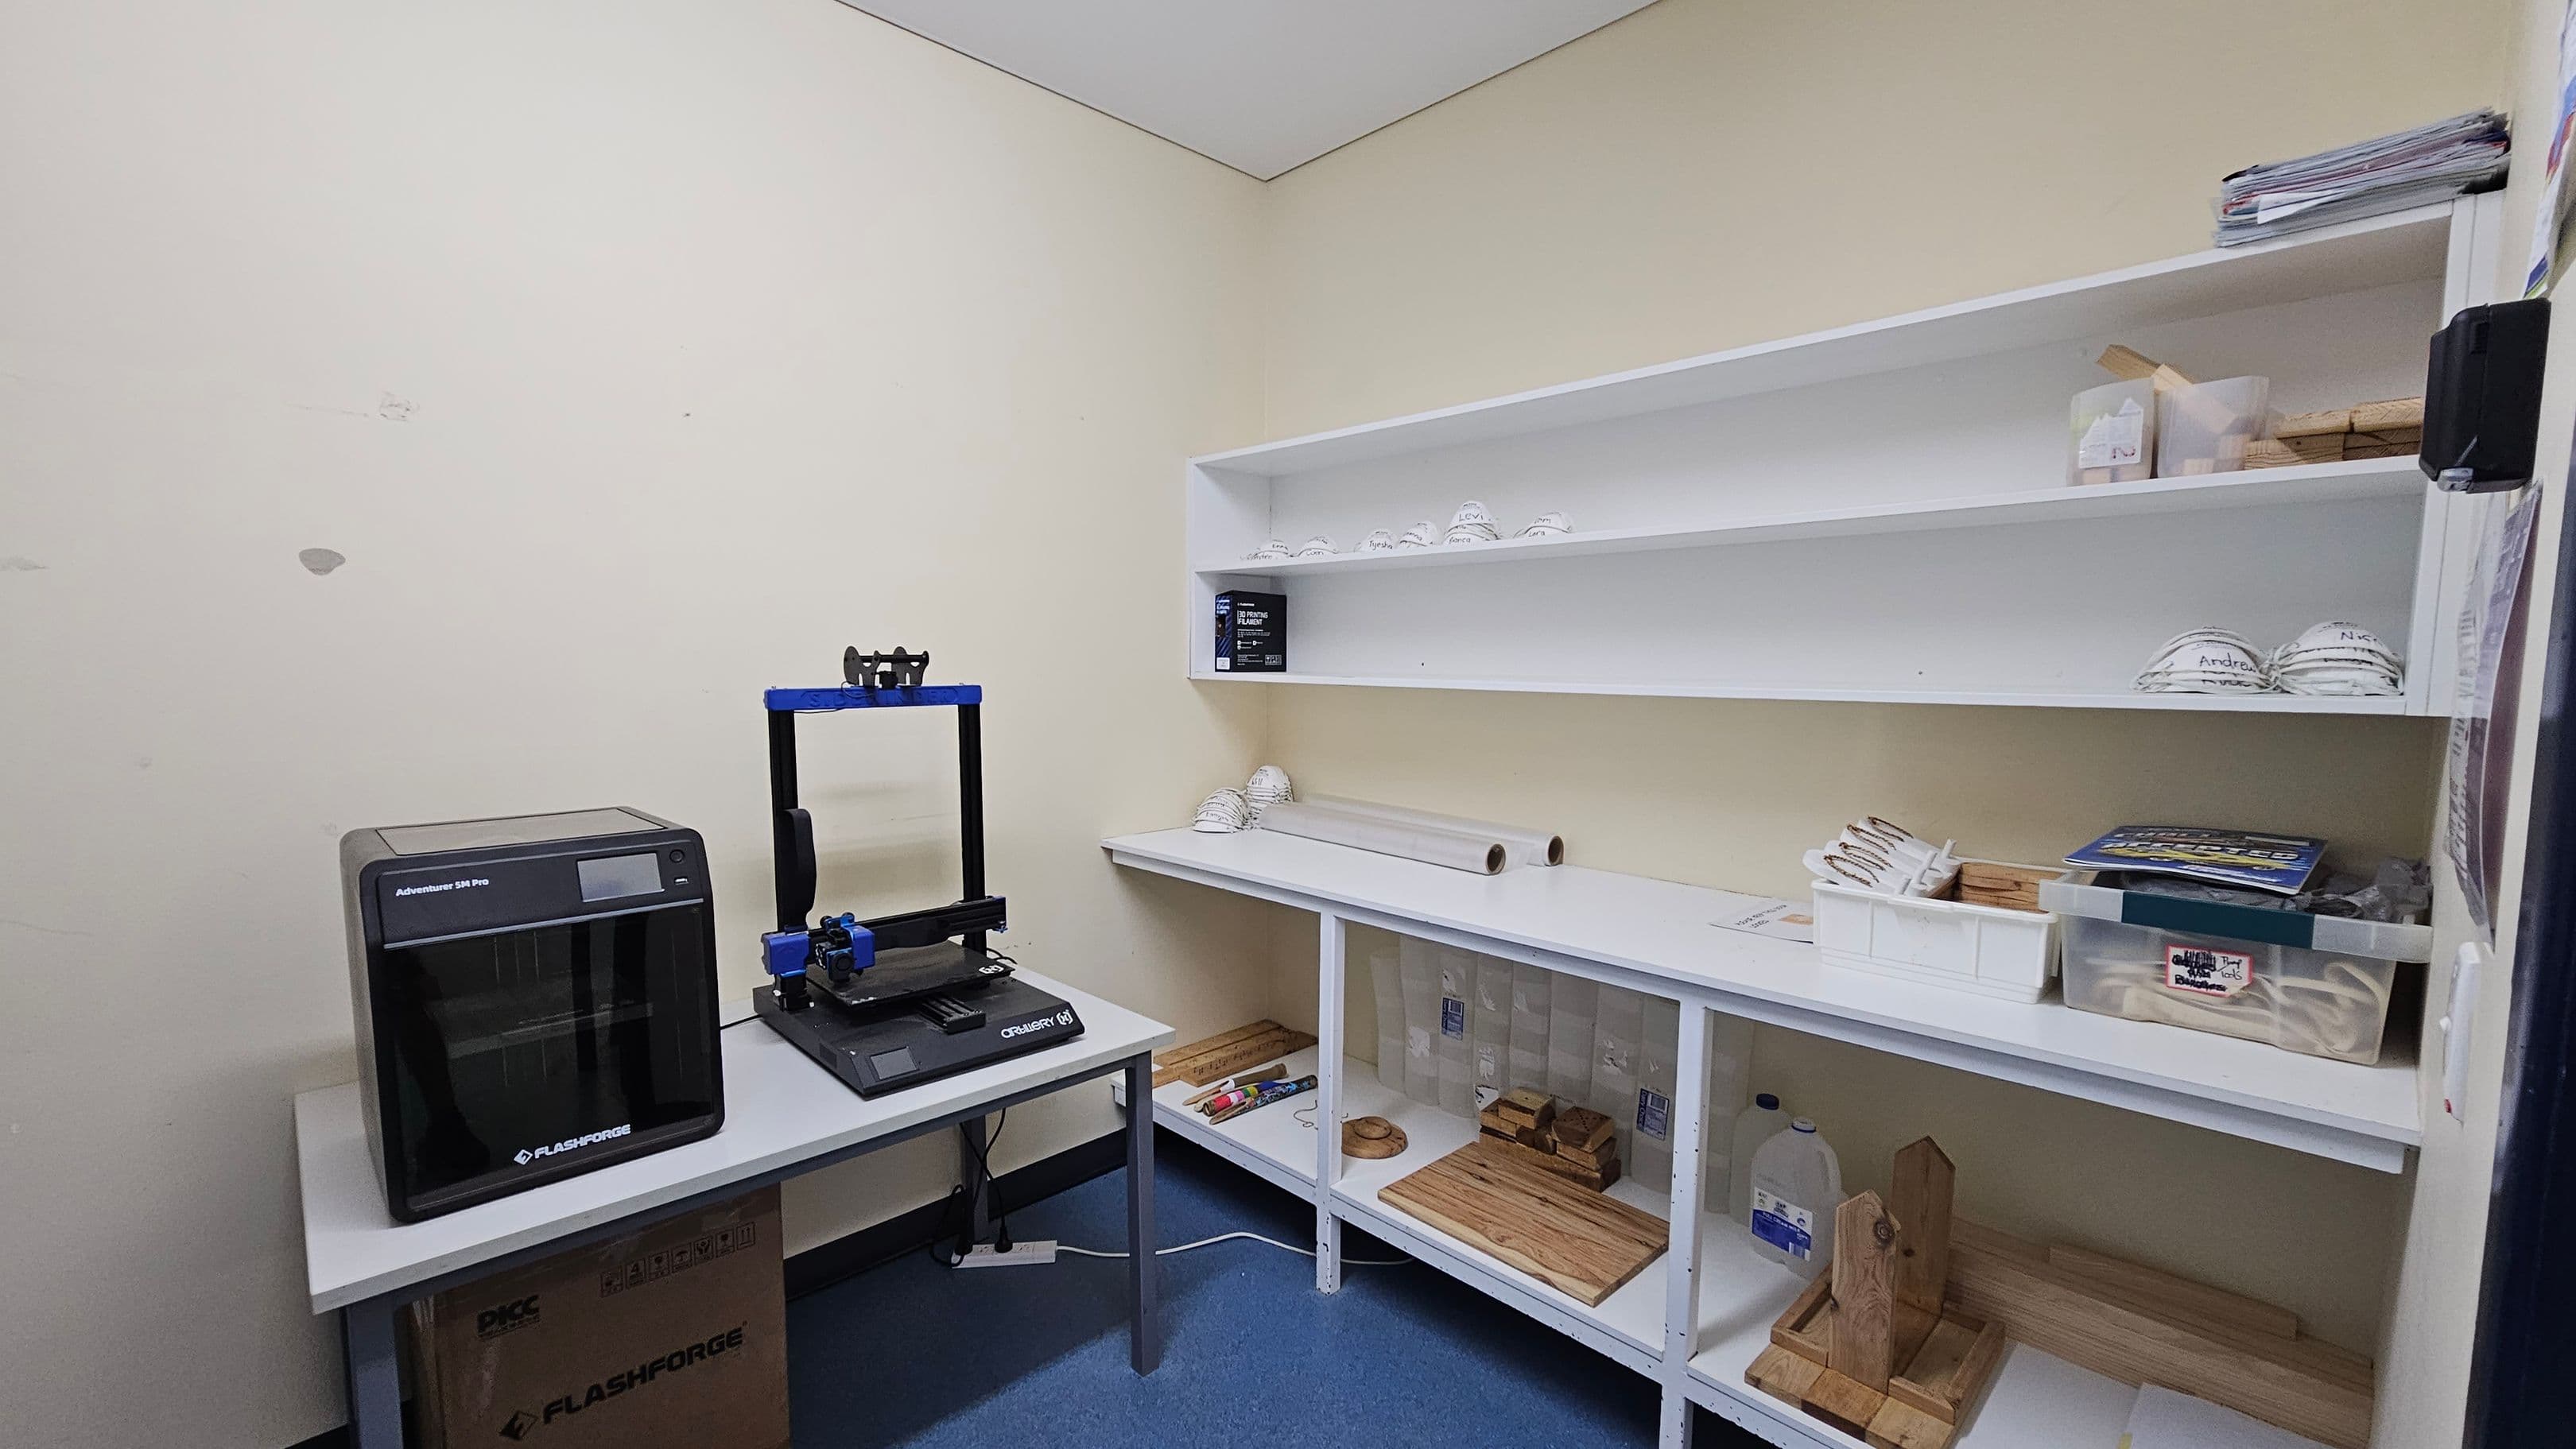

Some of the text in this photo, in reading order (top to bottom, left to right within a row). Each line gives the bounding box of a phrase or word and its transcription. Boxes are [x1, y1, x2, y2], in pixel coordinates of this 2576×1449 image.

[2100, 841, 2299, 860] ACCEPTED
[396, 883, 454, 896] Adventurer
[455, 879, 471, 889] 5M
[534, 1124, 631, 1159] FLASHFORGE
[542, 1327, 744, 1424] FLASHFORGE
